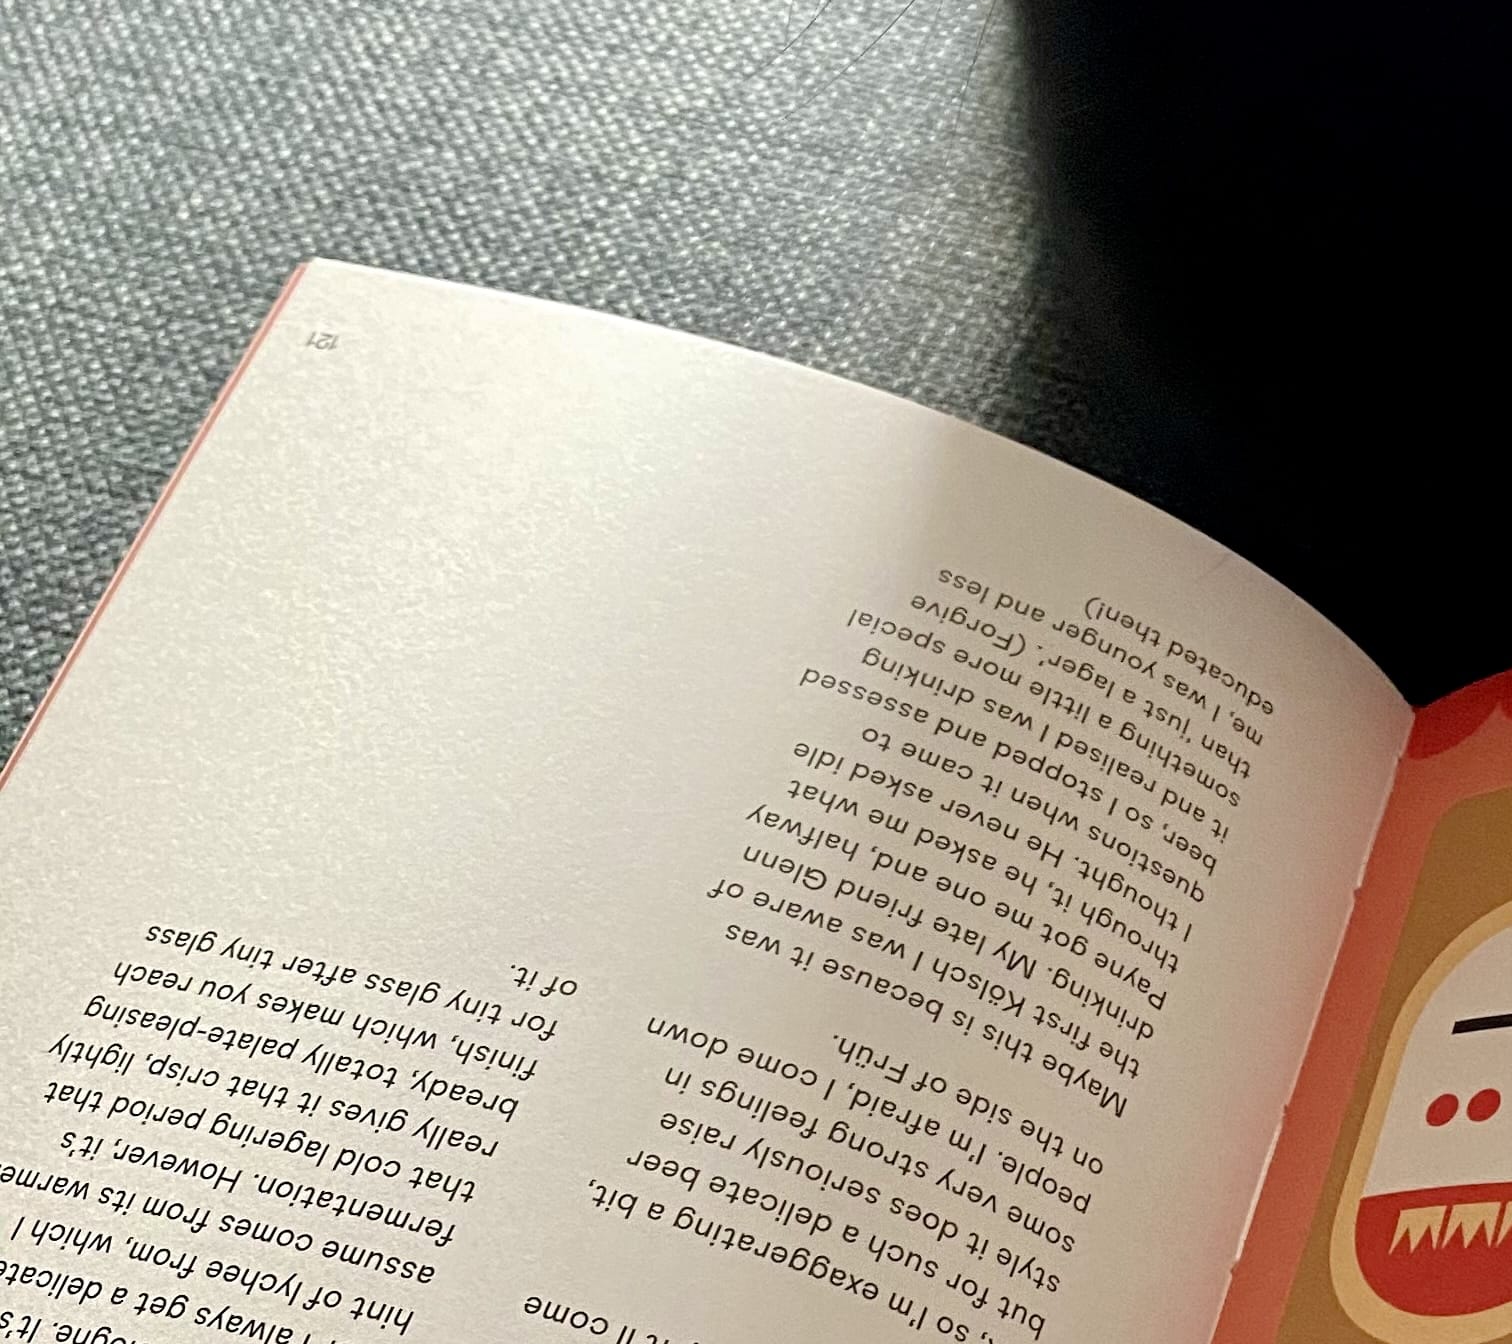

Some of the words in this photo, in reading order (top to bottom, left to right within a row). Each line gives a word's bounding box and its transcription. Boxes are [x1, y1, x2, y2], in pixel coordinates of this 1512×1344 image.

[305, 331, 340, 351] 121
[937, 568, 991, 605] less
[846, 608, 947, 655] special
[909, 594, 1027, 658] (Forgive
[1083, 595, 1162, 649] then!)
[952, 647, 1023, 688] more
[1050, 618, 1159, 680] younger
[798, 667, 930, 725] assessed
[860, 646, 977, 707] drinking
[1165, 639, 1275, 716] educated
[1028, 679, 1092, 726] little
[1142, 698, 1192, 745] ‘just
[792, 741, 846, 776] idle
[899, 741, 975, 781] came
[990, 740, 1105, 803] stopped
[1053, 730, 1158, 794] realised
[1117, 720, 1242, 808] something
[1199, 733, 1252, 781] than
[786, 779, 859, 818] what
[847, 761, 935, 805] asked
[744, 803, 861, 863] halfway
[938, 798, 1021, 842] never
[1009, 786, 1080, 833] when
[742, 844, 829, 892] Glenn
[912, 826, 999, 872] asked
[1086, 824, 1206, 904] questions
[1161, 822, 1219, 878] beer,
[751, 890, 845, 934] aware
[832, 877, 925, 929] friend
[1073, 855, 1179, 933] thought.
[143, 924, 219, 958] glass
[218, 935, 276, 972] tiny
[932, 915, 988, 957] late
[1079, 900, 1180, 975] through
[112, 960, 195, 993] reach
[280, 954, 359, 988] after
[363, 972, 443, 1008] glass
[821, 957, 946, 1025] because
[931, 956, 1028, 1019] Kölsch
[1093, 951, 1168, 1012] Payne
[82, 993, 302, 1061] palate-pleasing
[255, 991, 347, 1027] makes
[442, 988, 503, 1026] tiny
[1046, 966, 1155, 1042] drinking.
[351, 1012, 439, 1051] which
[646, 1015, 730, 1060] down
[981, 1023, 1035, 1065] this
[1031, 1004, 1093, 1052] first
[46, 1032, 137, 1078] lightly
[144, 1052, 221, 1088] crisp,
[299, 1042, 399, 1090] totally
[449, 1033, 539, 1083] finish,
[736, 1046, 819, 1088] come
[832, 1033, 911, 1086] Früh.
[42, 1080, 105, 1114] that
[224, 1074, 290, 1110] that
[408, 1068, 521, 1124] bready,
[698, 1079, 820, 1141] feelings
[846, 1081, 942, 1138] afraid,
[955, 1087, 1014, 1126] side
[1041, 1053, 1129, 1120] Maybe
[105, 1094, 209, 1132] period
[327, 1098, 410, 1135] gives
[659, 1111, 738, 1152] raise
[59, 1130, 106, 1162] it’s
[207, 1111, 332, 1169] lagering
[409, 1115, 500, 1159] really
[826, 1119, 931, 1180] strong
[111, 1137, 245, 1195] However,
[330, 1146, 403, 1179] cold
[406, 1165, 477, 1205] that
[625, 1149, 702, 1194] beer
[740, 1136, 882, 1206] seriously
[996, 1150, 1093, 1216] people.
[252, 1172, 457, 1249] fermentation.
[587, 1178, 640, 1221] bit,
[707, 1174, 834, 1237] delicate
[934, 1167, 998, 1215] very
[29, 1218, 114, 1257] which
[140, 1195, 213, 1235] from
[217, 1213, 315, 1253] comes
[888, 1196, 960, 1243] does
[1006, 1204, 1077, 1254] some
[124, 1235, 199, 1281] from,
[320, 1239, 437, 1285] assume
[671, 1205, 880, 1302] exaggerating
[867, 1233, 940, 1280] such
[995, 1246, 1062, 1294] style
[204, 1259, 305, 1308] lychee
[348, 1295, 416, 1338] hint
[523, 1295, 610, 1337] come
[887, 1291, 930, 1332] I’m
